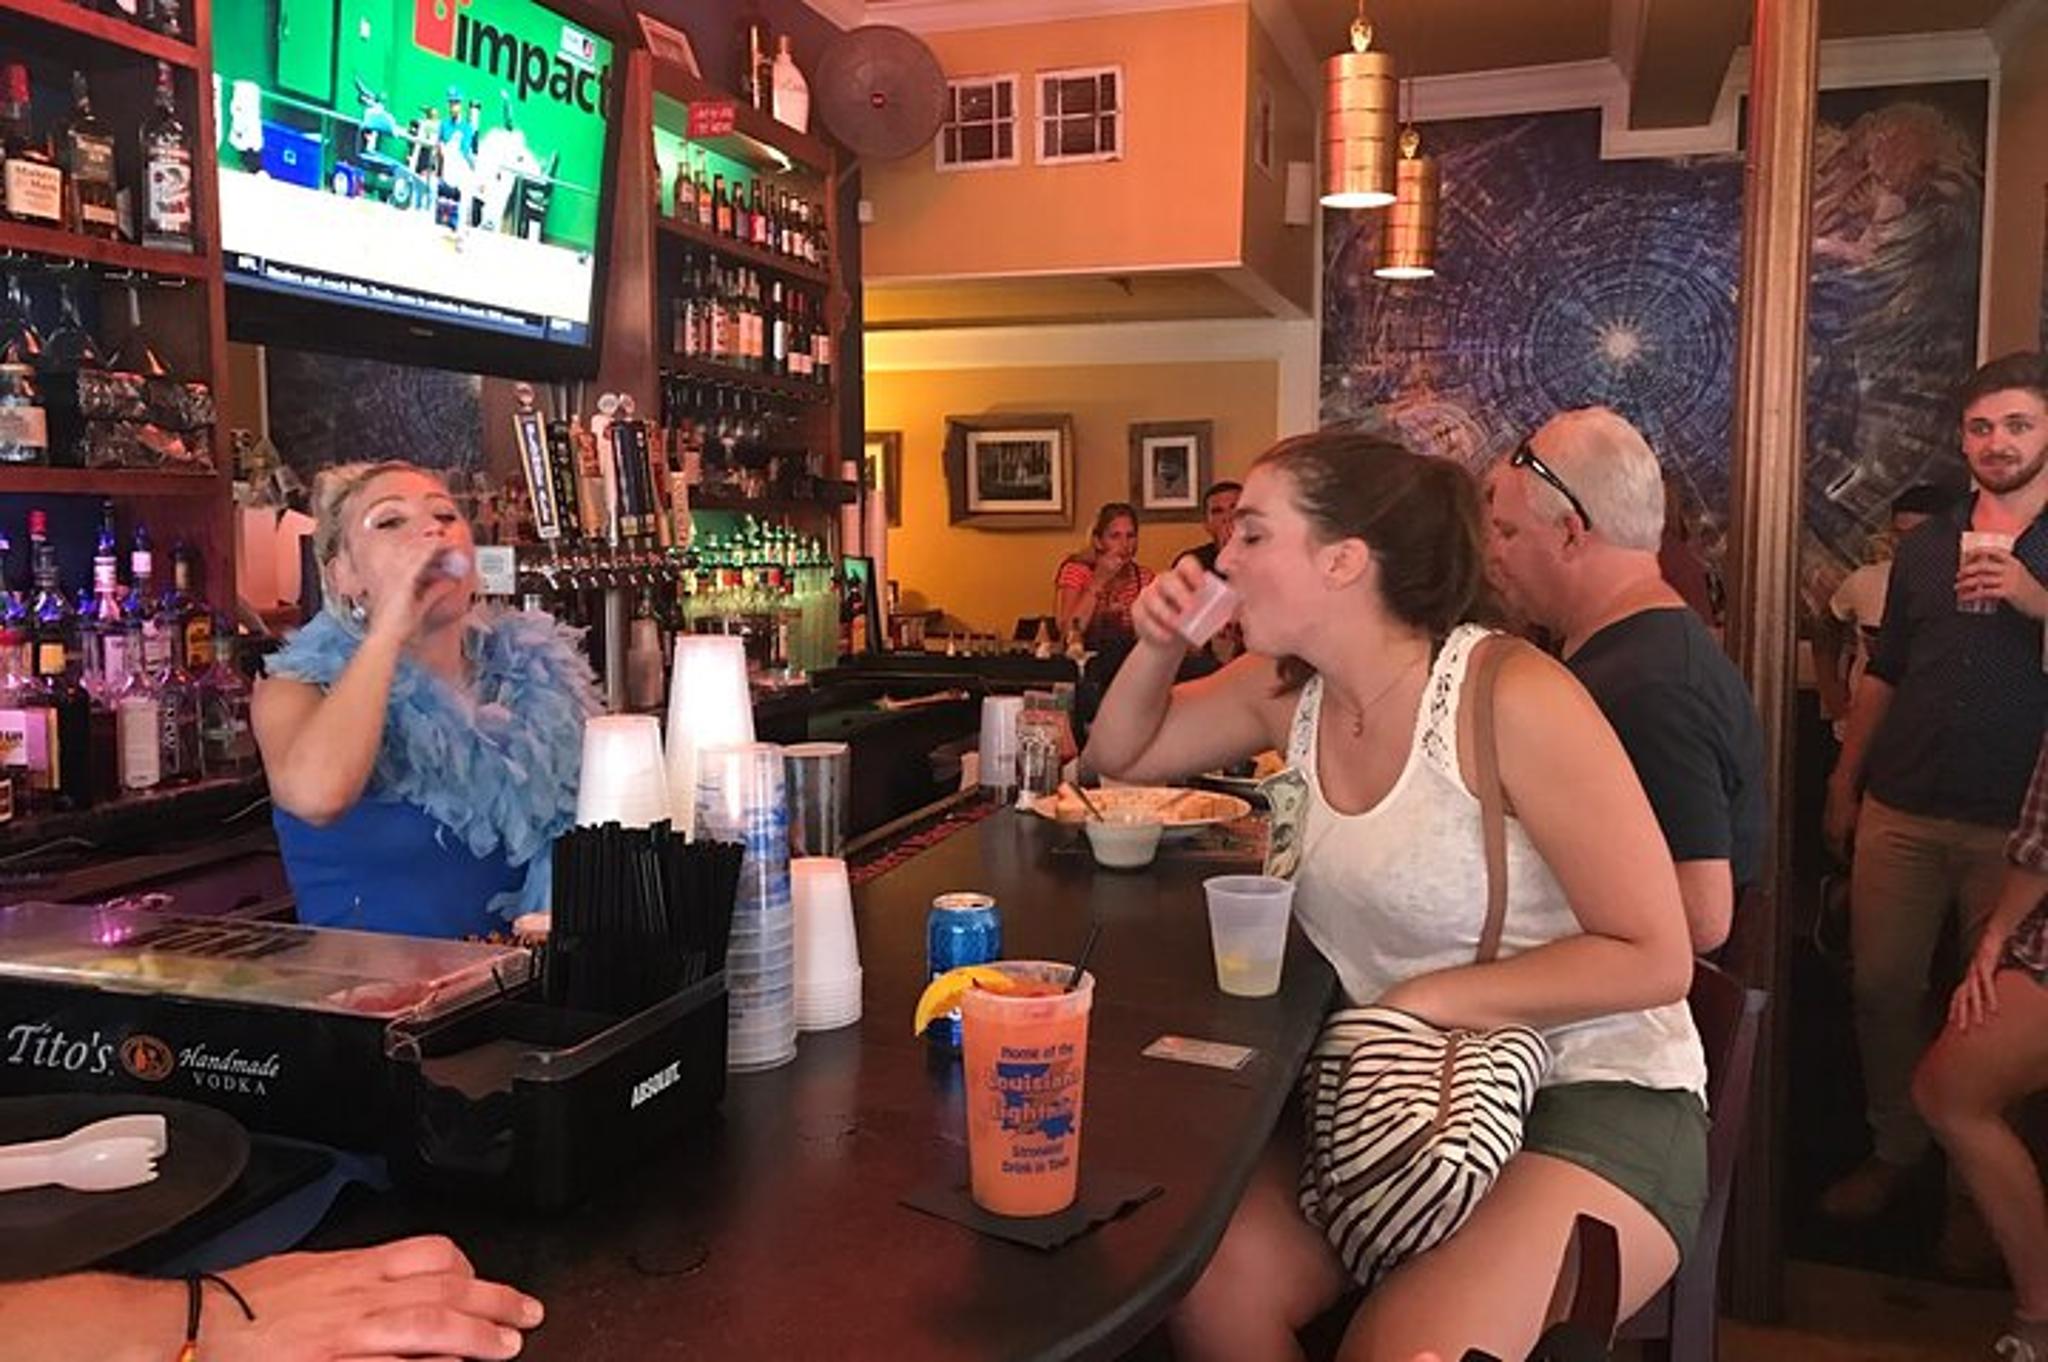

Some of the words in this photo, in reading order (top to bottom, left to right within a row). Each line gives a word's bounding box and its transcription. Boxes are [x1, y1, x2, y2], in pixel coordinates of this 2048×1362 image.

[456, 3, 607, 121] impact
[179, 1043, 281, 1078] Handmade
[1001, 1045, 1039, 1059] Home
[1043, 1045, 1056, 1059] of
[1058, 1042, 1074, 1056] the
[192, 1071, 267, 1096] VODKA
